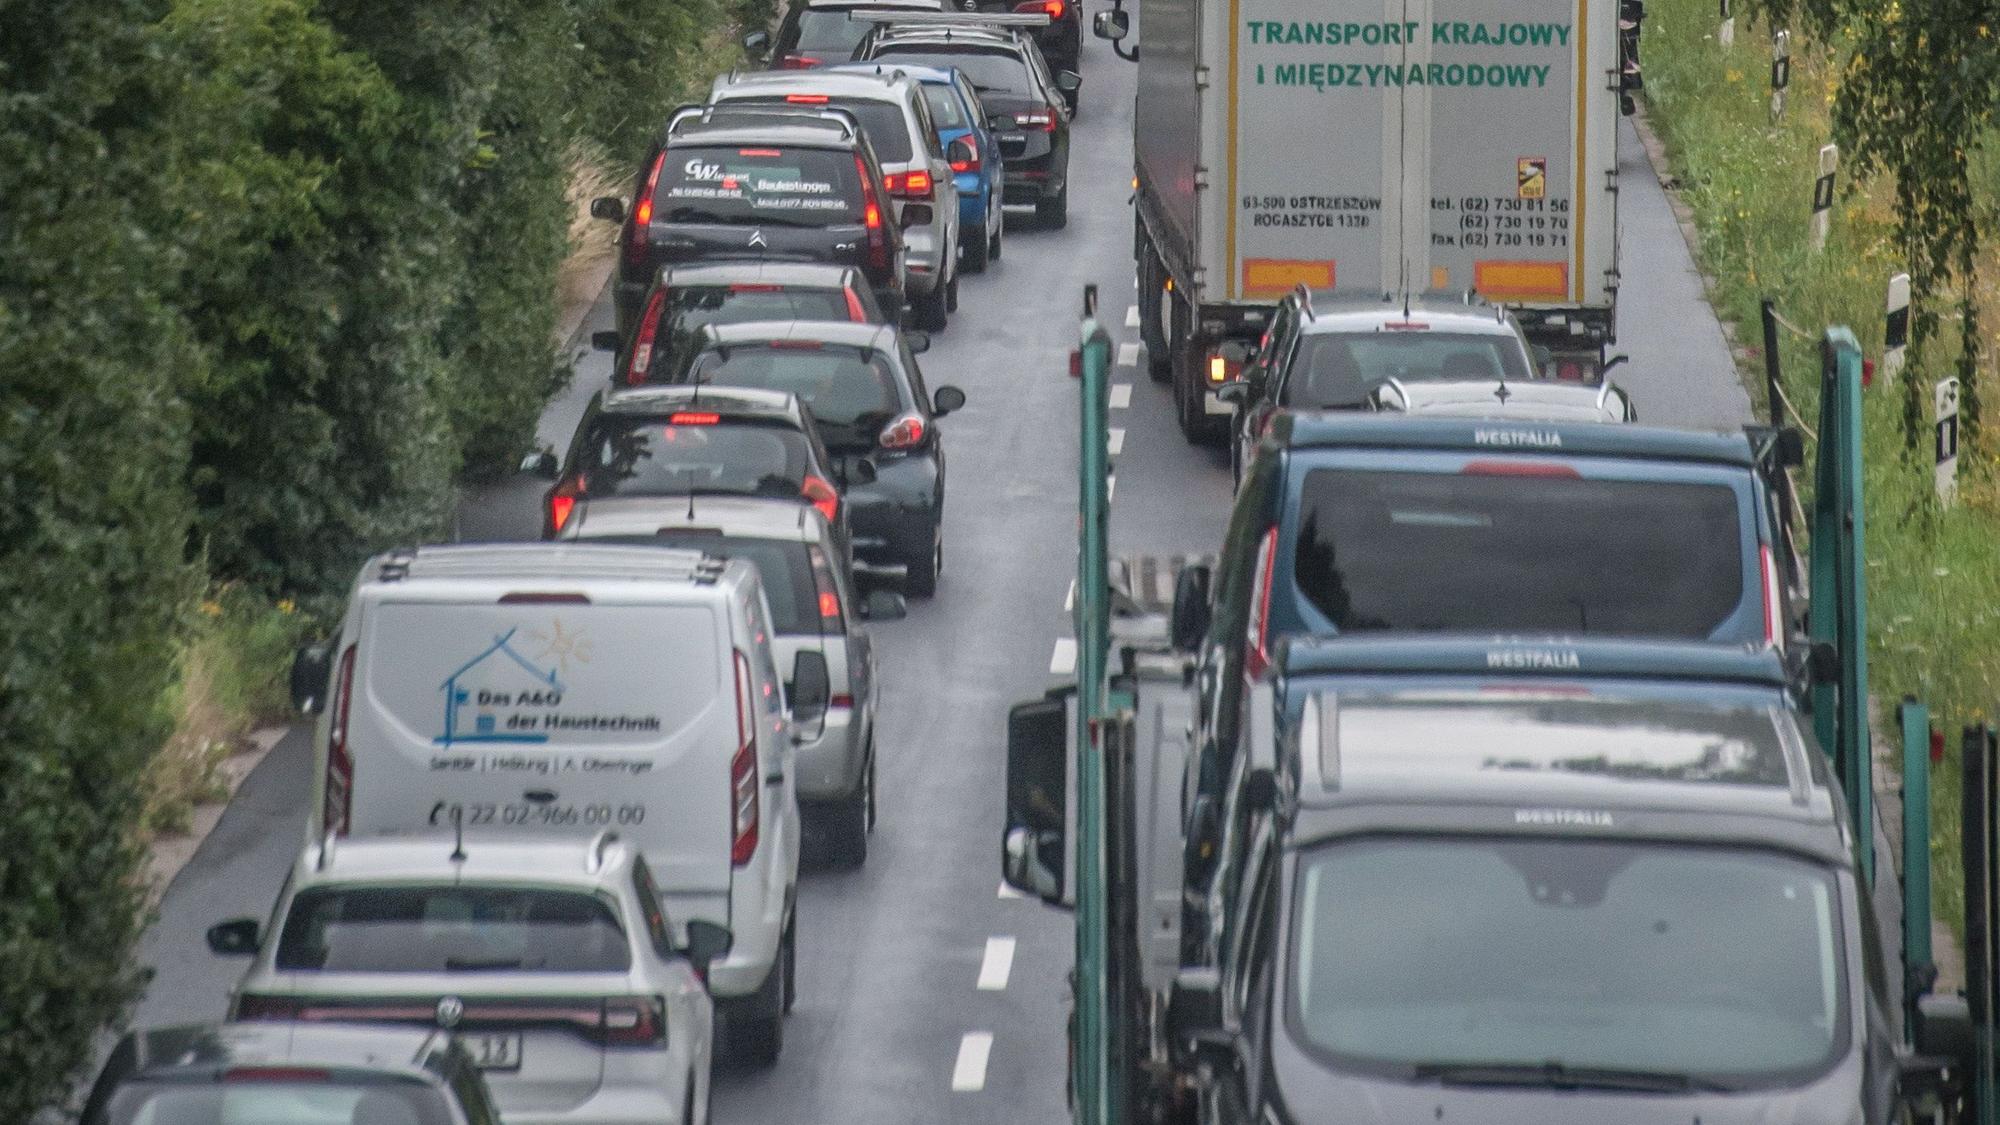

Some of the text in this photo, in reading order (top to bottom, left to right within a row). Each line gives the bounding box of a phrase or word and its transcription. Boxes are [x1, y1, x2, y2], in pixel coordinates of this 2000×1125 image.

[1247, 21, 1573, 47] TRANSPORT KRAJOWY
[1256, 63, 1551, 93] I MIĘDZYNARODOWY
[1494, 198, 1521, 212] 730
[1494, 215, 1521, 230] 730
[1527, 216, 1545, 230] 19
[1431, 232, 1567, 249] fax (62) 730 19 71
[1474, 429, 1563, 447] WESTFALIA
[1486, 649, 1580, 669] WESTFALIA
[477, 688, 511, 706] Das
[506, 714, 661, 732] der Haustechnik
[583, 804, 611, 825] 00
[617, 804, 646, 825] 00
[1514, 808, 1614, 826] WESTFALIA
